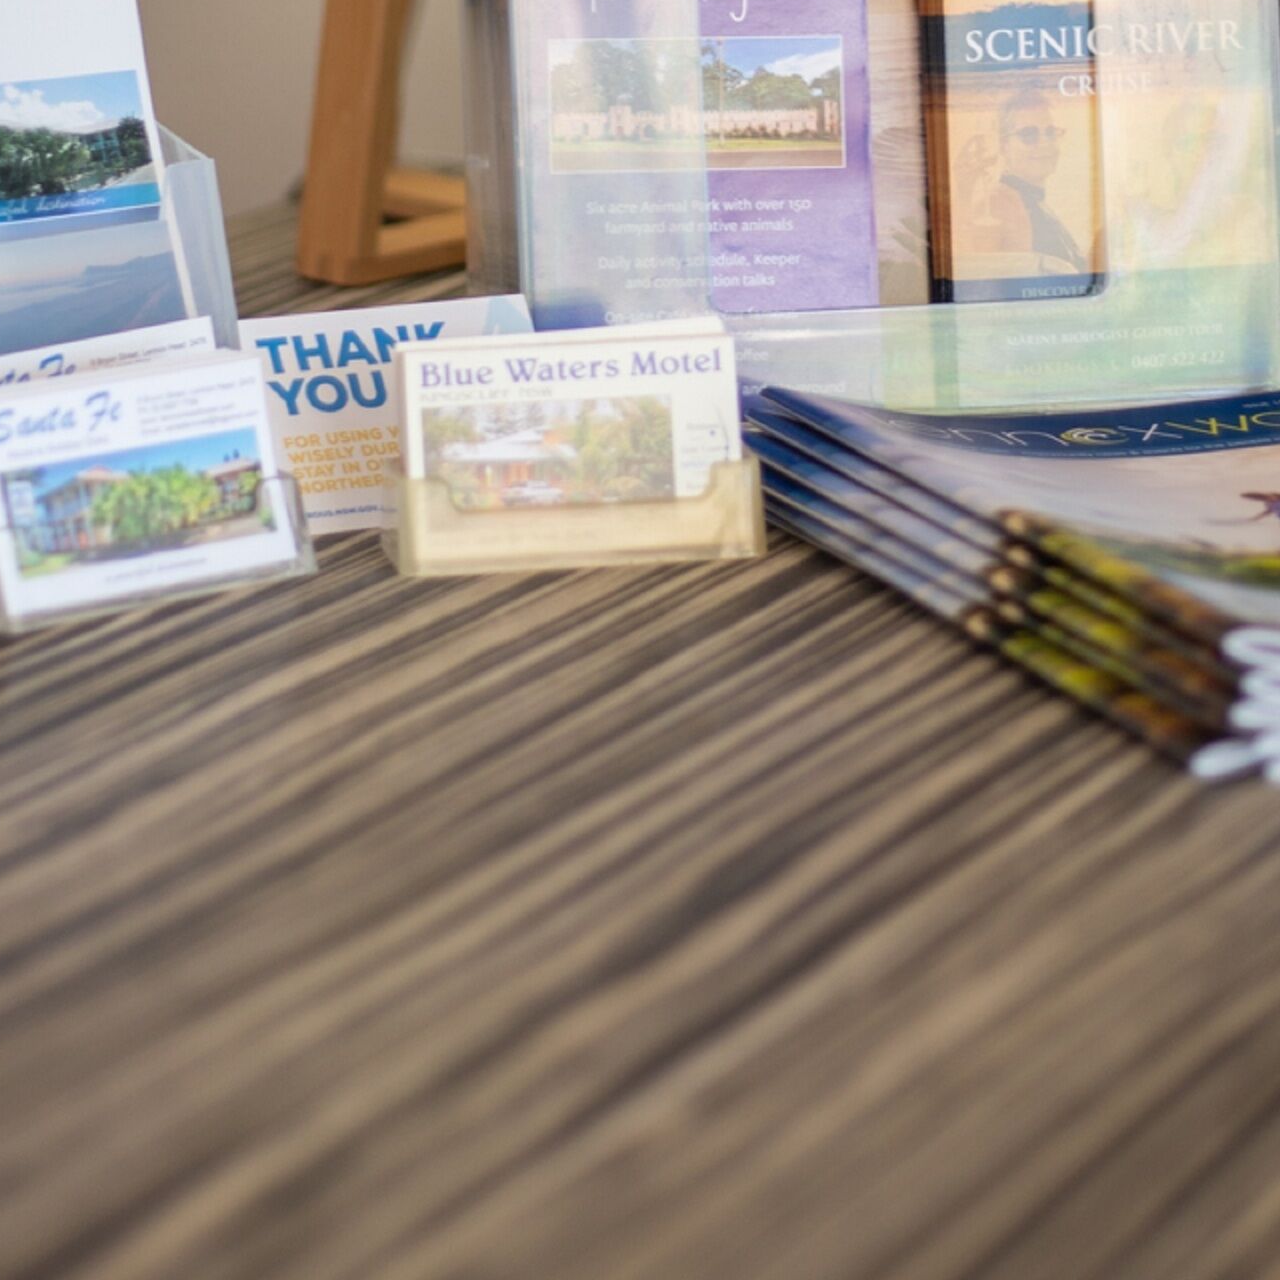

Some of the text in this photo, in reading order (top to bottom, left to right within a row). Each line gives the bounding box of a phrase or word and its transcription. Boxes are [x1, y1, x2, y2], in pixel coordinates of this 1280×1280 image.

[965, 20, 1245, 64] SCENIC RIVER
[1058, 70, 1154, 98] CRUISE
[723, 197, 753, 212] with
[755, 200, 785, 212] over
[788, 199, 813, 214] 150
[741, 216, 794, 233] animals
[753, 253, 802, 270] Keeper
[742, 273, 777, 288] talks
[420, 348, 723, 387] Blue Waters Motel
[266, 370, 388, 415] YOU
[85, 390, 124, 433] Fe
[283, 433, 321, 449] FOR
[325, 426, 383, 446] USING
[288, 446, 355, 465] WISELY
[293, 463, 336, 480] STAY
[342, 459, 360, 475] IN
